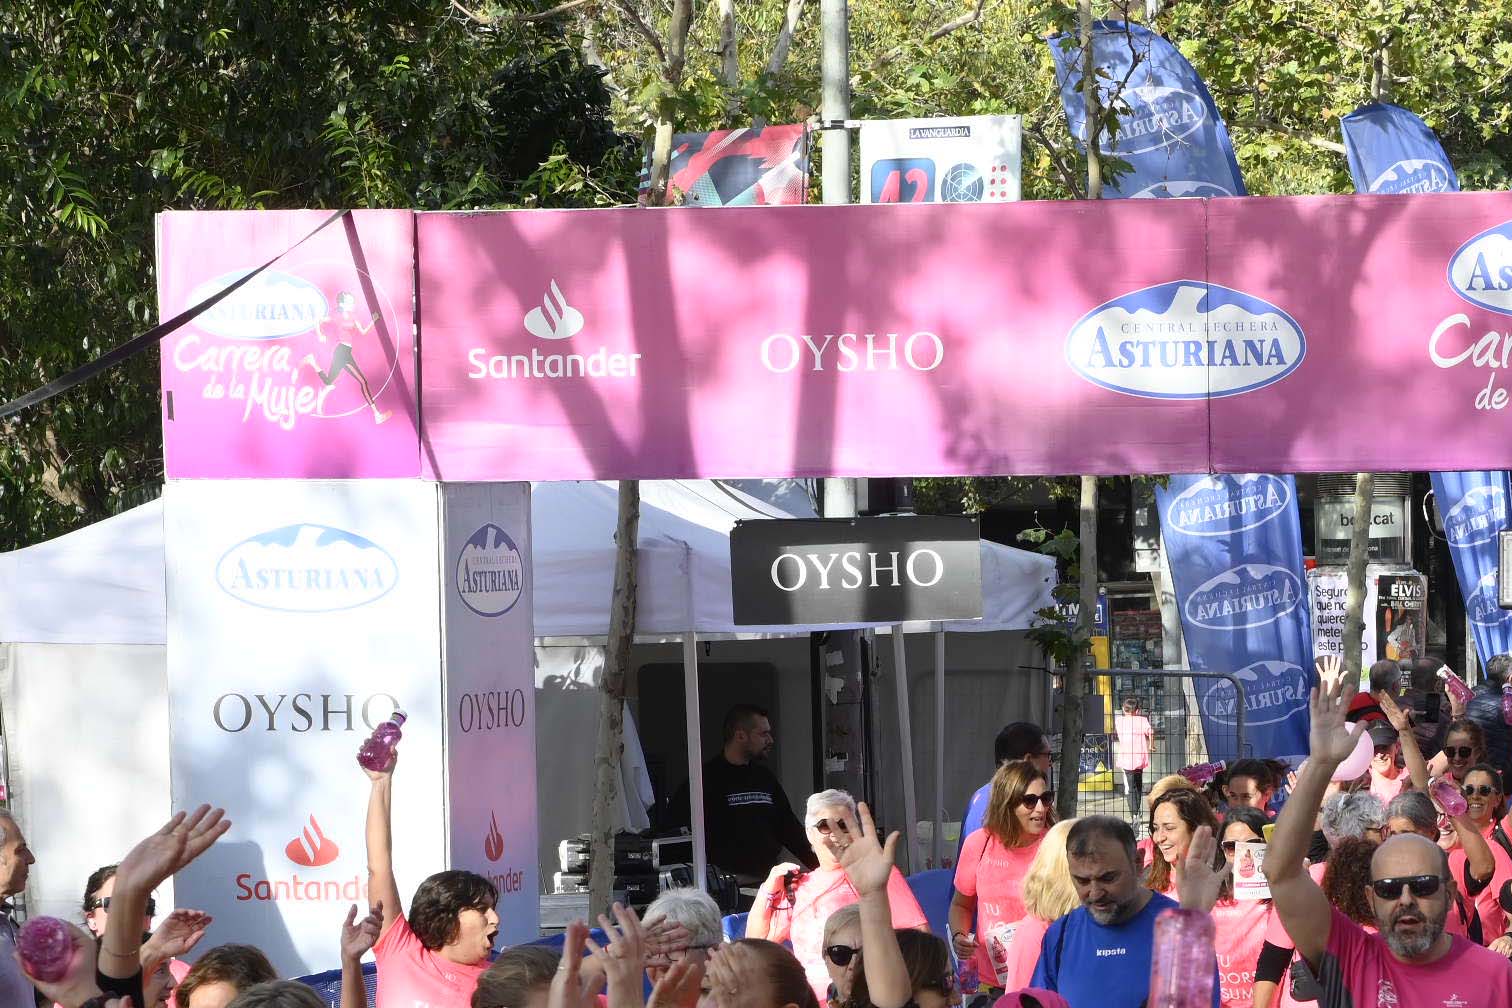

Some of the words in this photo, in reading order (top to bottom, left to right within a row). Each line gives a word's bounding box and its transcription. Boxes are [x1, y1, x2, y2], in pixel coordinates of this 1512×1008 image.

[920, 127, 969, 137] VANGUARDIA
[1121, 321, 1196, 336] CENTRAL
[1203, 319, 1280, 334] LECHERA
[174, 333, 293, 373] Carrera
[467, 346, 641, 380] Santander
[760, 330, 944, 374] OYSHO
[1087, 325, 1289, 369] ASTURIANA
[203, 374, 225, 400] de
[229, 372, 245, 400] la
[242, 367, 335, 432] Mujer
[1475, 372, 1509, 410] de
[231, 556, 386, 591] ASTURIANA
[462, 561, 520, 594] ASTURIANA
[771, 549, 944, 592] OYSHO
[1391, 584, 1421, 597] ELVIS
[1316, 602, 1333, 613] que
[1317, 614, 1348, 627] quiere
[1318, 641, 1337, 652] este
[212, 693, 401, 732] OYSHO
[459, 688, 525, 733] OYSHO
[983, 902, 1000, 916] TU
[1096, 947, 1127, 958] kipsta
[1220, 986, 1254, 1000] SUM
